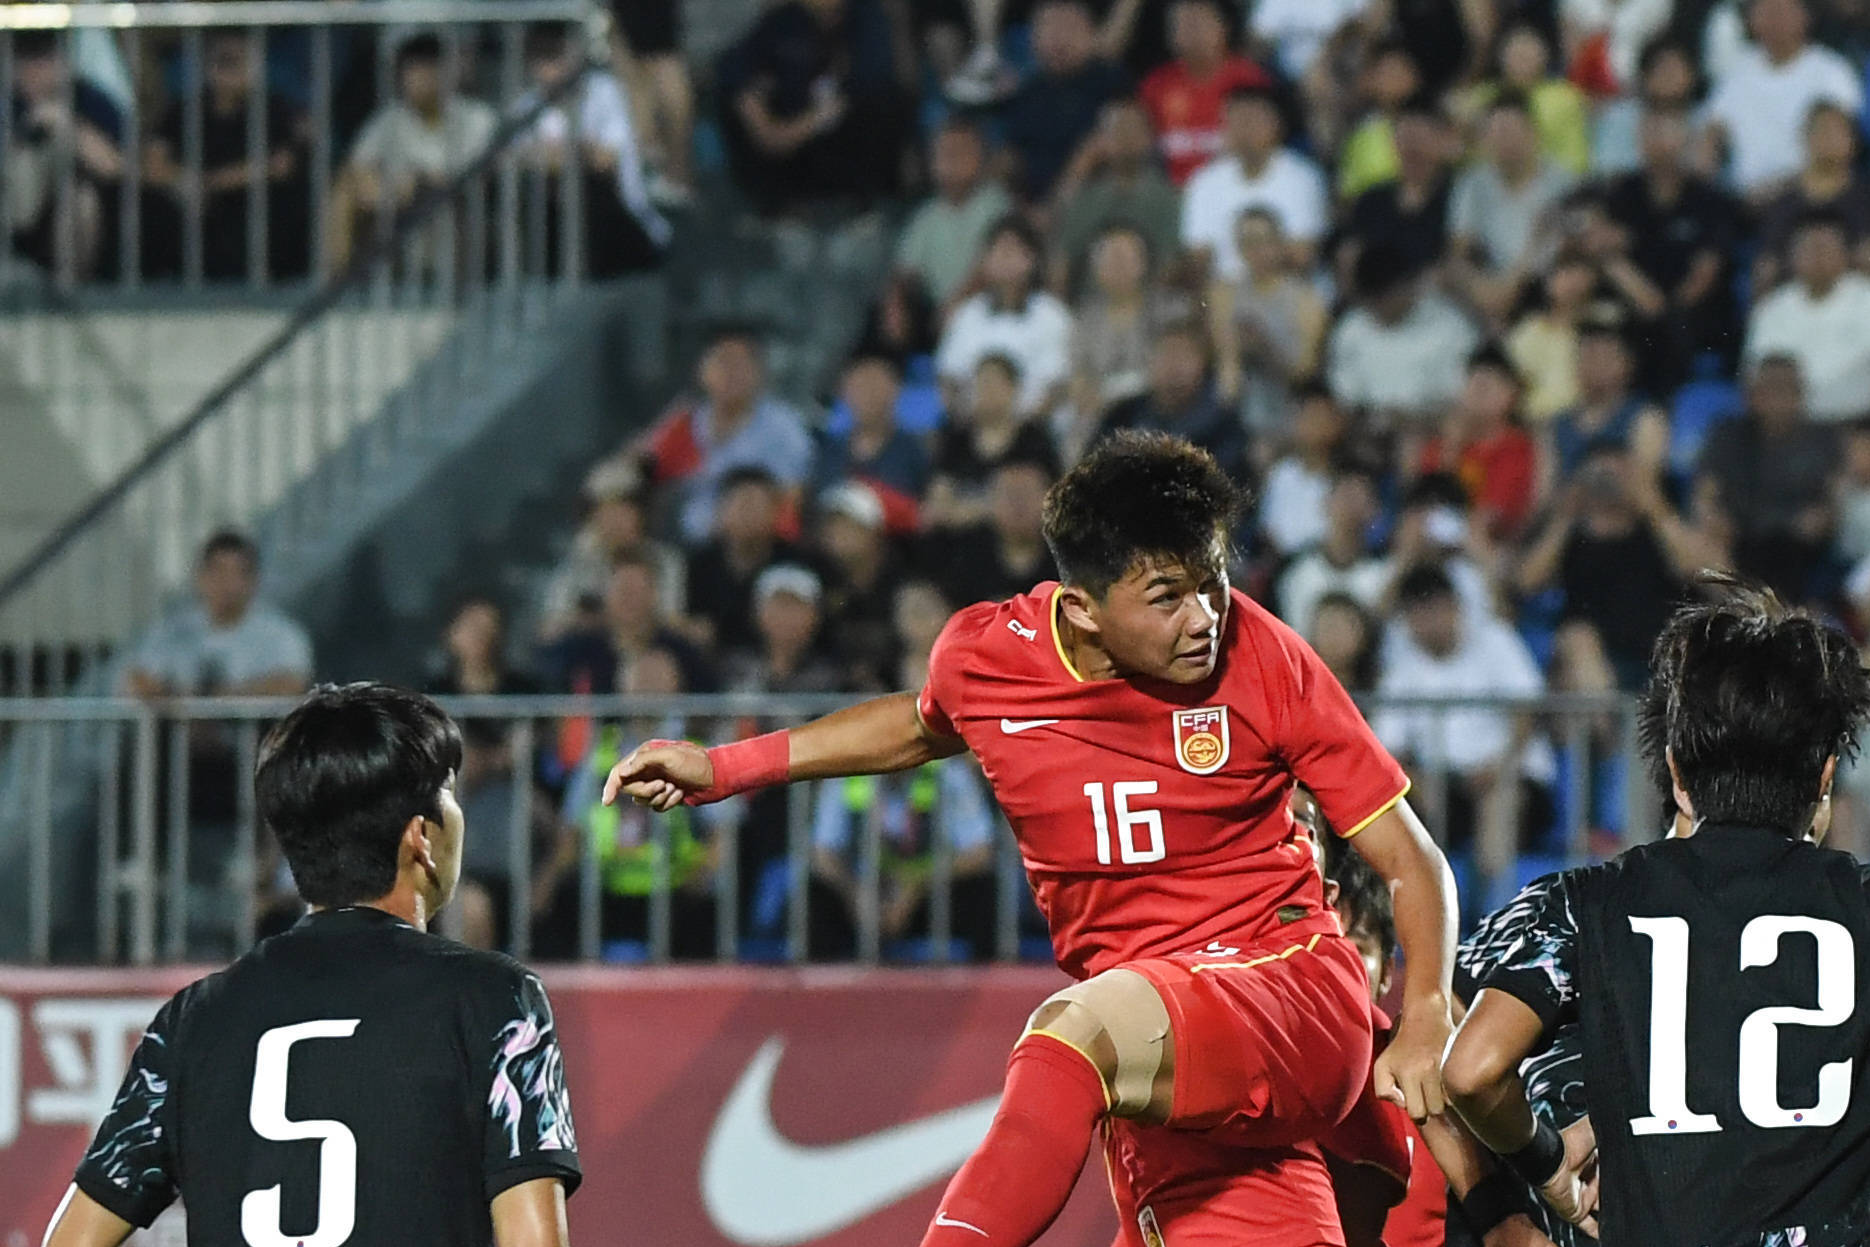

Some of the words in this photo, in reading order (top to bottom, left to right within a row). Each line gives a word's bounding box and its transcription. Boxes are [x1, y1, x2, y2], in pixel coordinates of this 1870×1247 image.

[1180, 711, 1220, 727] CFA
[1083, 780, 1166, 865] 16
[1628, 914, 1856, 1136] 12
